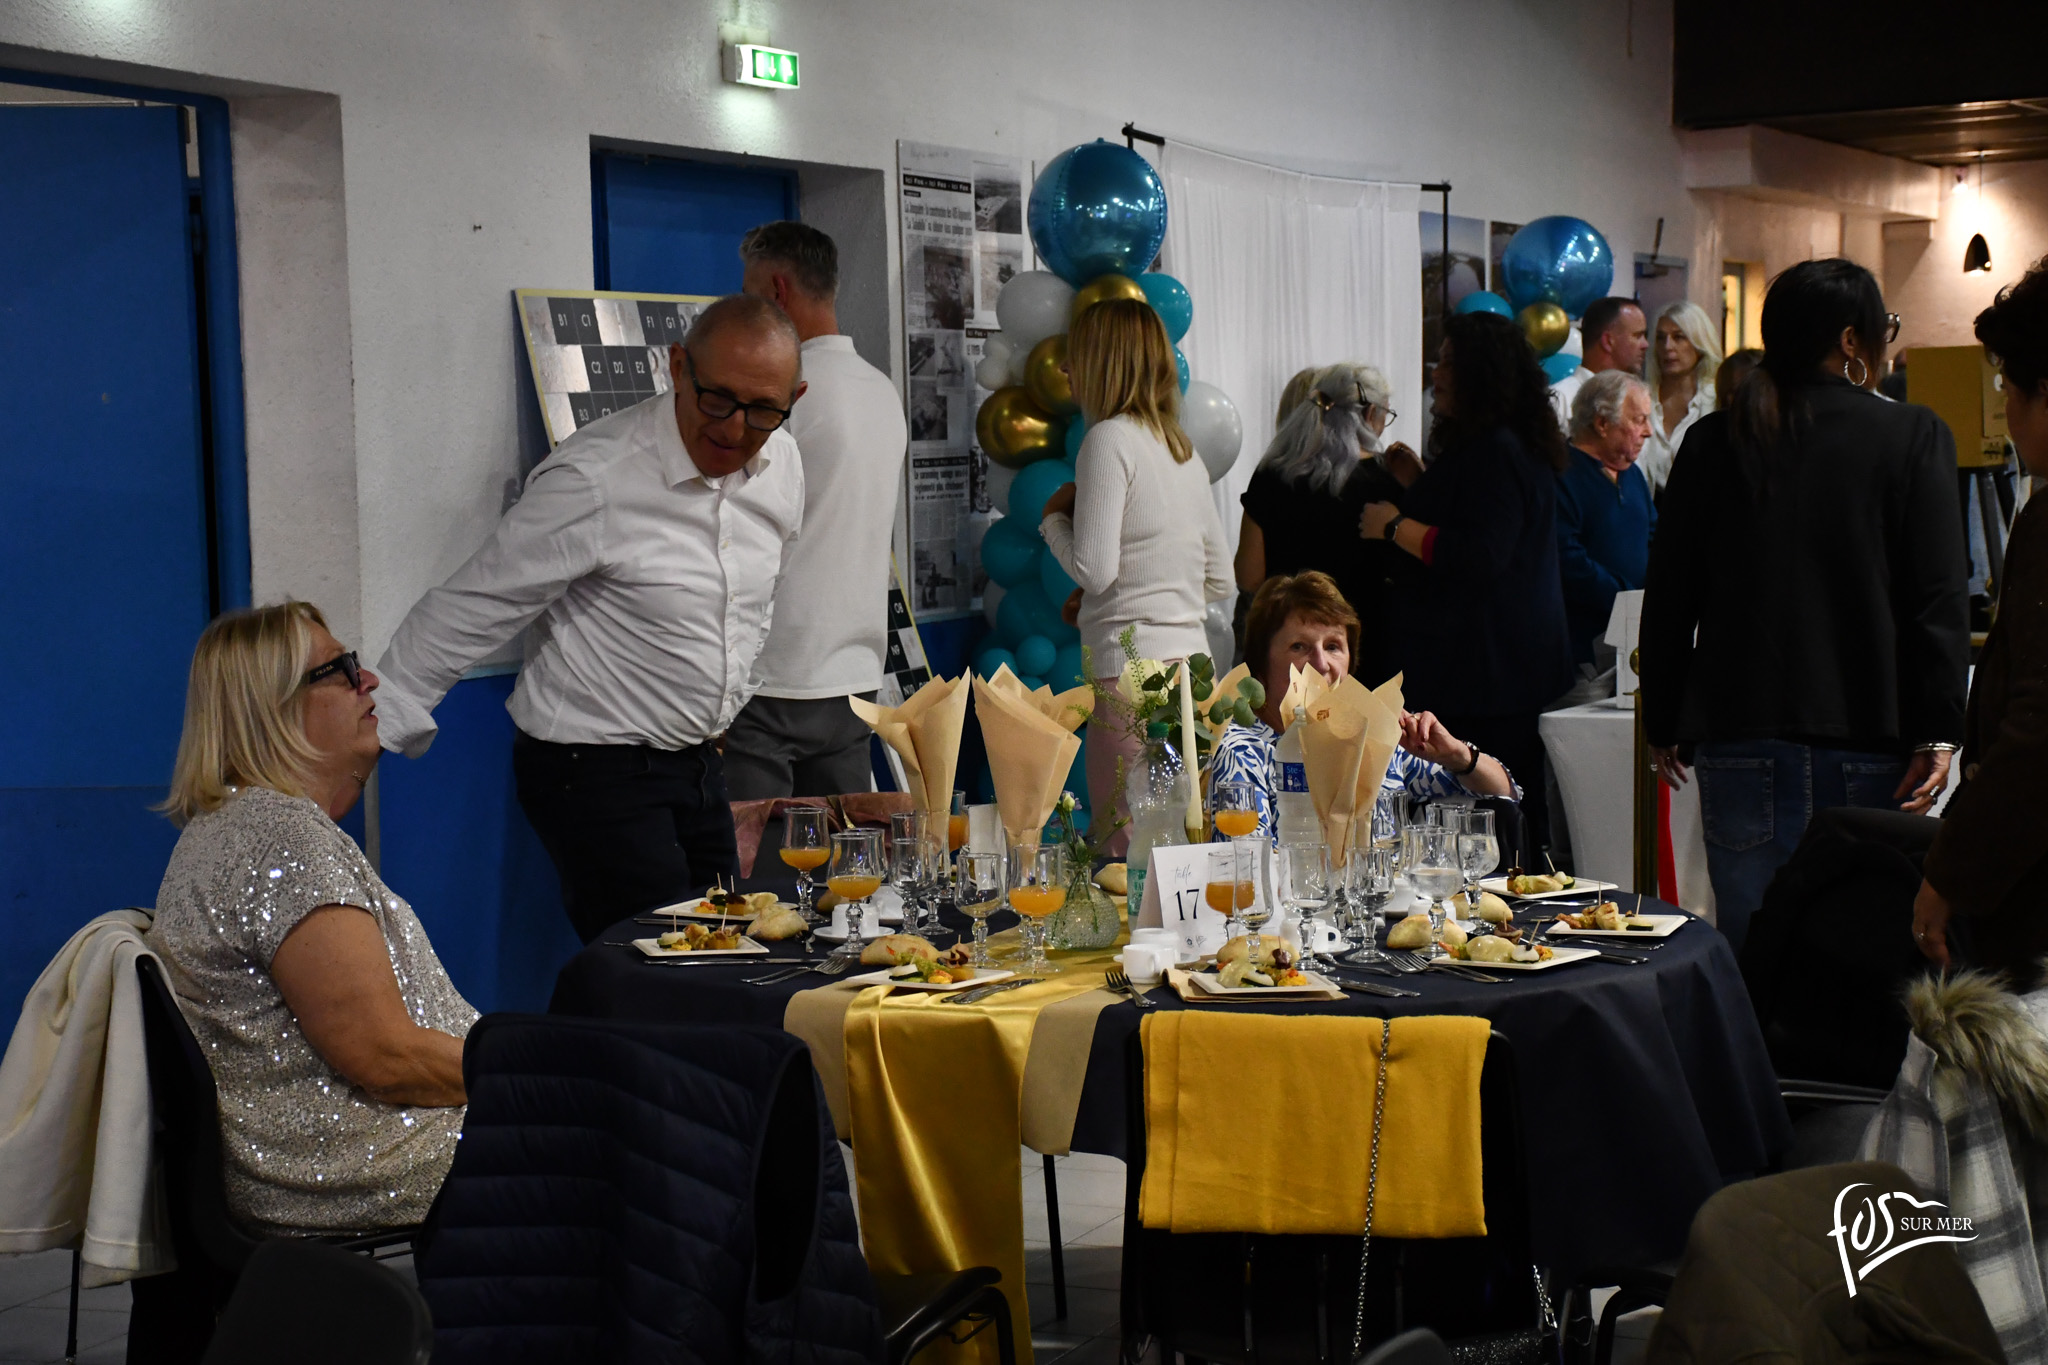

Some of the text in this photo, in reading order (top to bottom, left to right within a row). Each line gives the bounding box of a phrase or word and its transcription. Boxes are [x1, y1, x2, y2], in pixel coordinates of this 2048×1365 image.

[557, 313, 676, 329] B1 C1 F1 G1
[591, 361, 646, 374] C2 D2 E2
[578, 408, 590, 421] B3
[1174, 888, 1200, 921] 17
